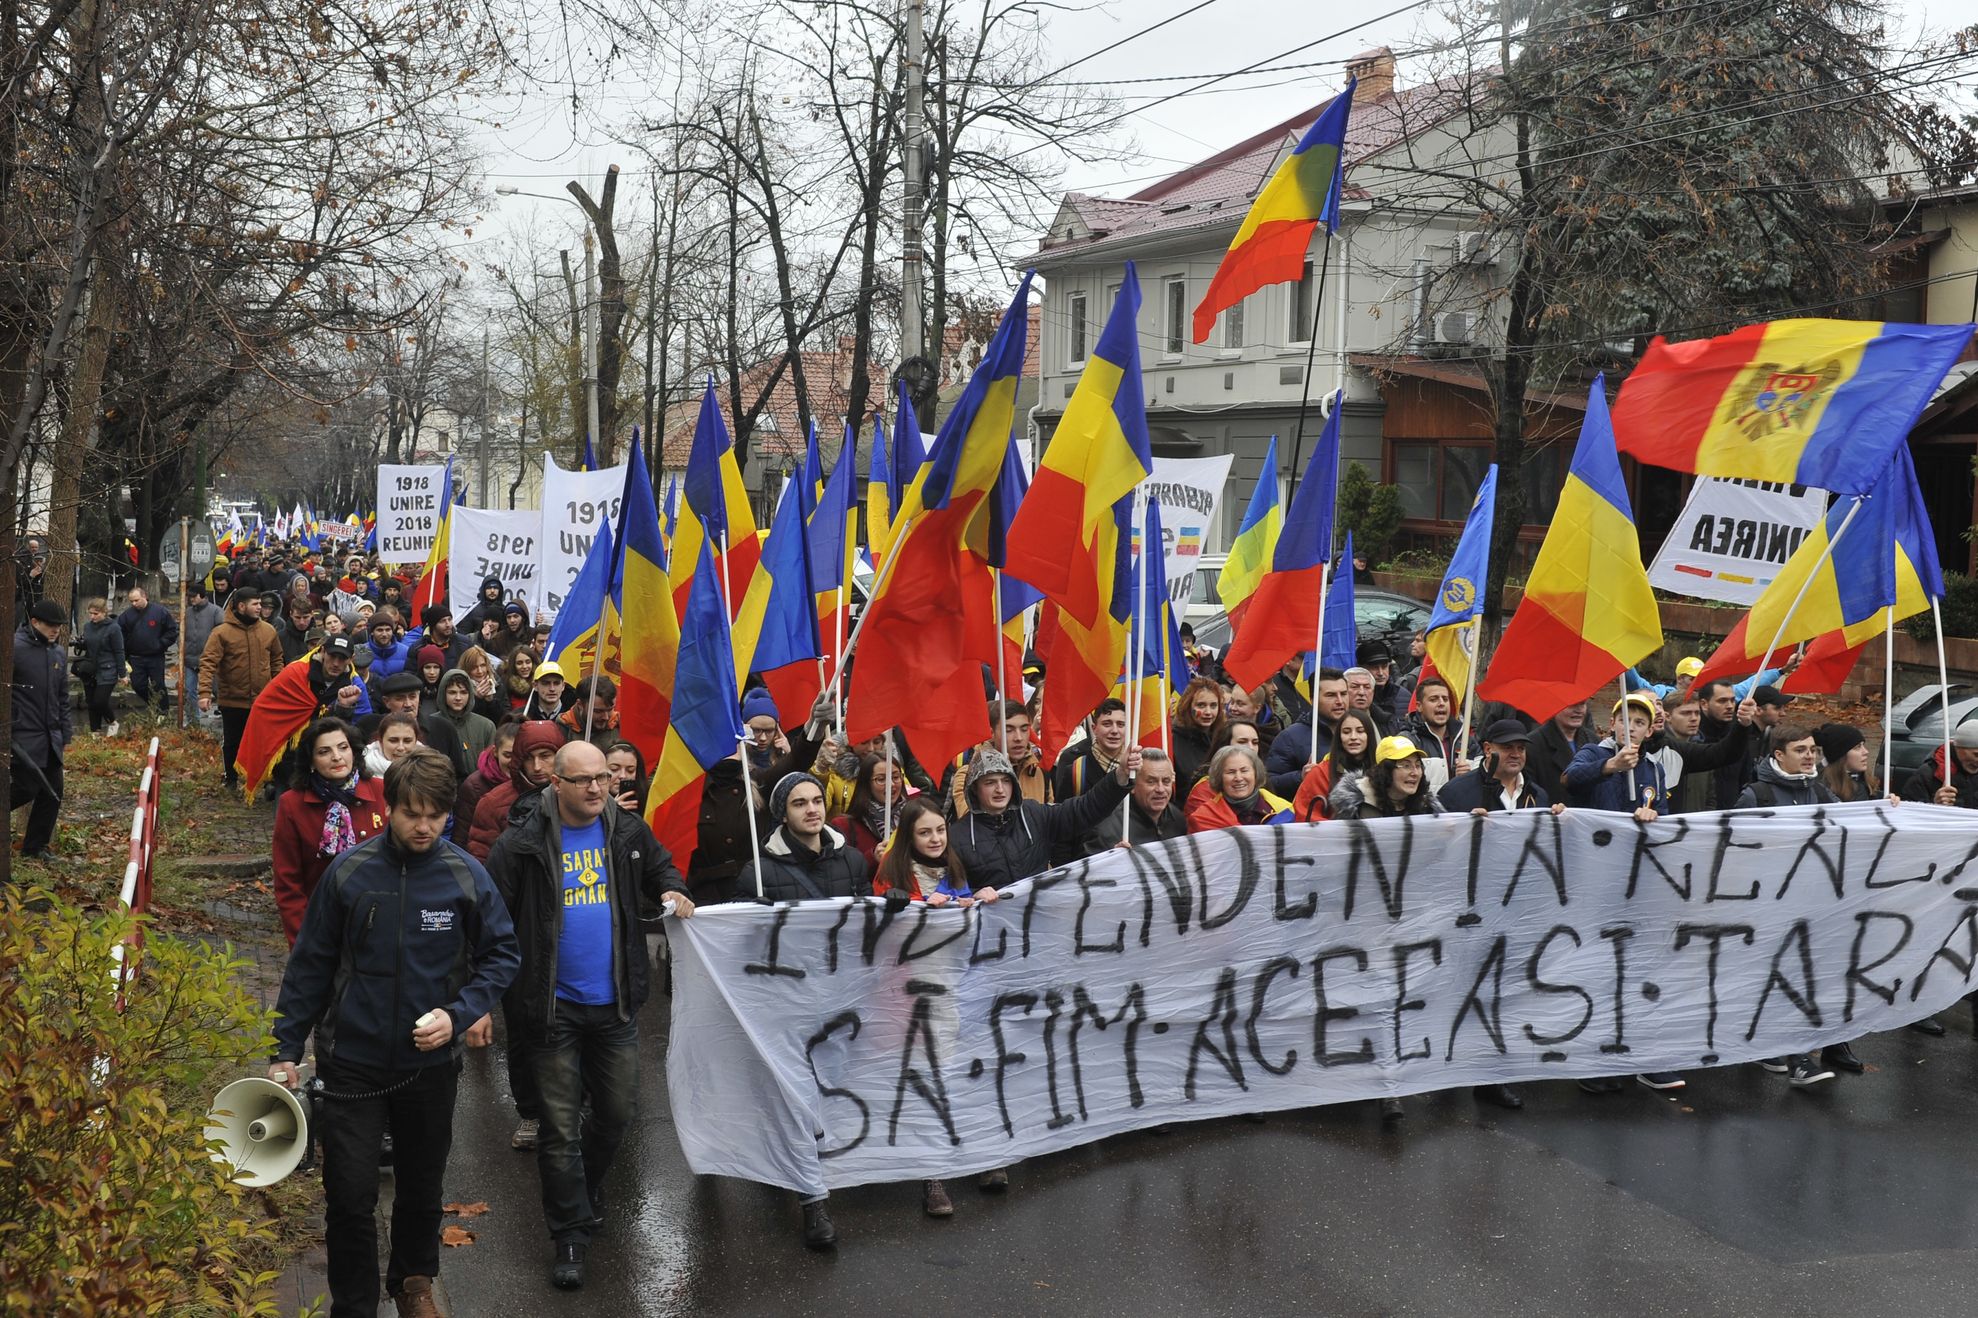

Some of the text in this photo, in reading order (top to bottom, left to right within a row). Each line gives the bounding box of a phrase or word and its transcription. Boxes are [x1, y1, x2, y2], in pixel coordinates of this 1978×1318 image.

[396, 476, 429, 491] 1918
[390, 494, 435, 511] UNIRE
[566, 497, 621, 525] 1918
[395, 516, 432, 531] 2018
[990, 981, 1147, 1140] FIM
